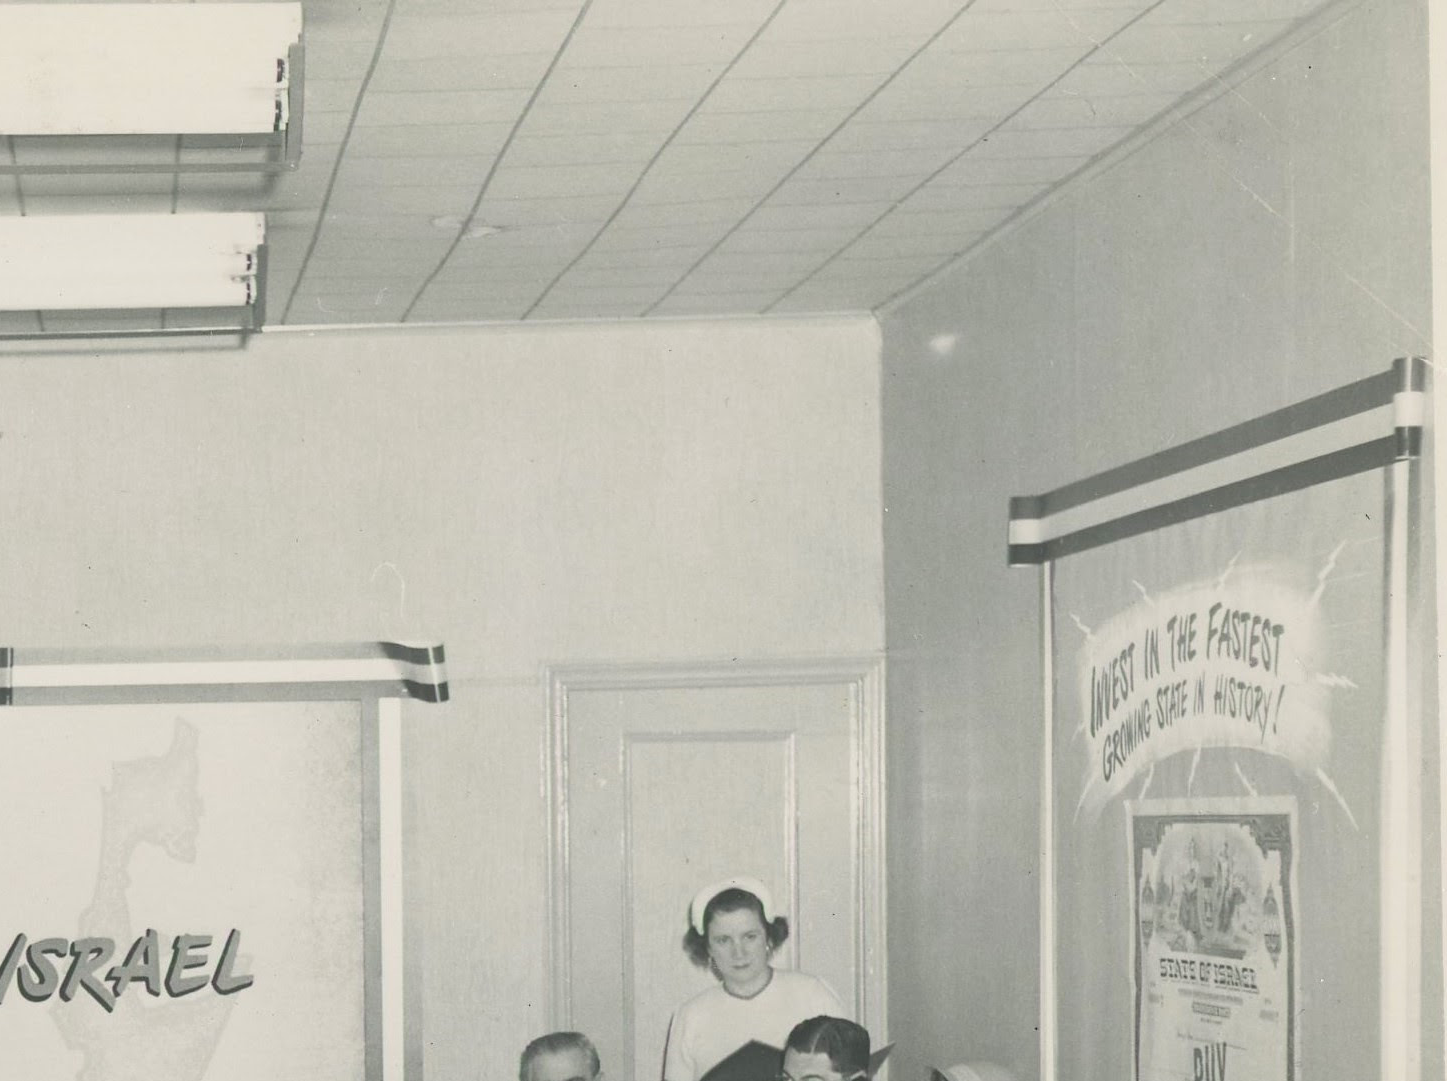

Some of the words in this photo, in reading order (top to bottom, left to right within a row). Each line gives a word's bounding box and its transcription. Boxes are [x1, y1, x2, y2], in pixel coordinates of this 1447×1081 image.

[1090, 642, 1135, 738] INVEST
[1144, 627, 1160, 680] IN
[1167, 612, 1197, 672] THE
[1206, 601, 1285, 677] FASTEST
[1103, 699, 1151, 782] GROWING
[1156, 680, 1187, 730] STATE
[1193, 669, 1205, 716] IN
[1214, 674, 1285, 744] HISTORY!
[1160, 958, 1196, 979] STATE
[1200, 961, 1212, 982] OF
[1214, 963, 1258, 990] ISRAEL
